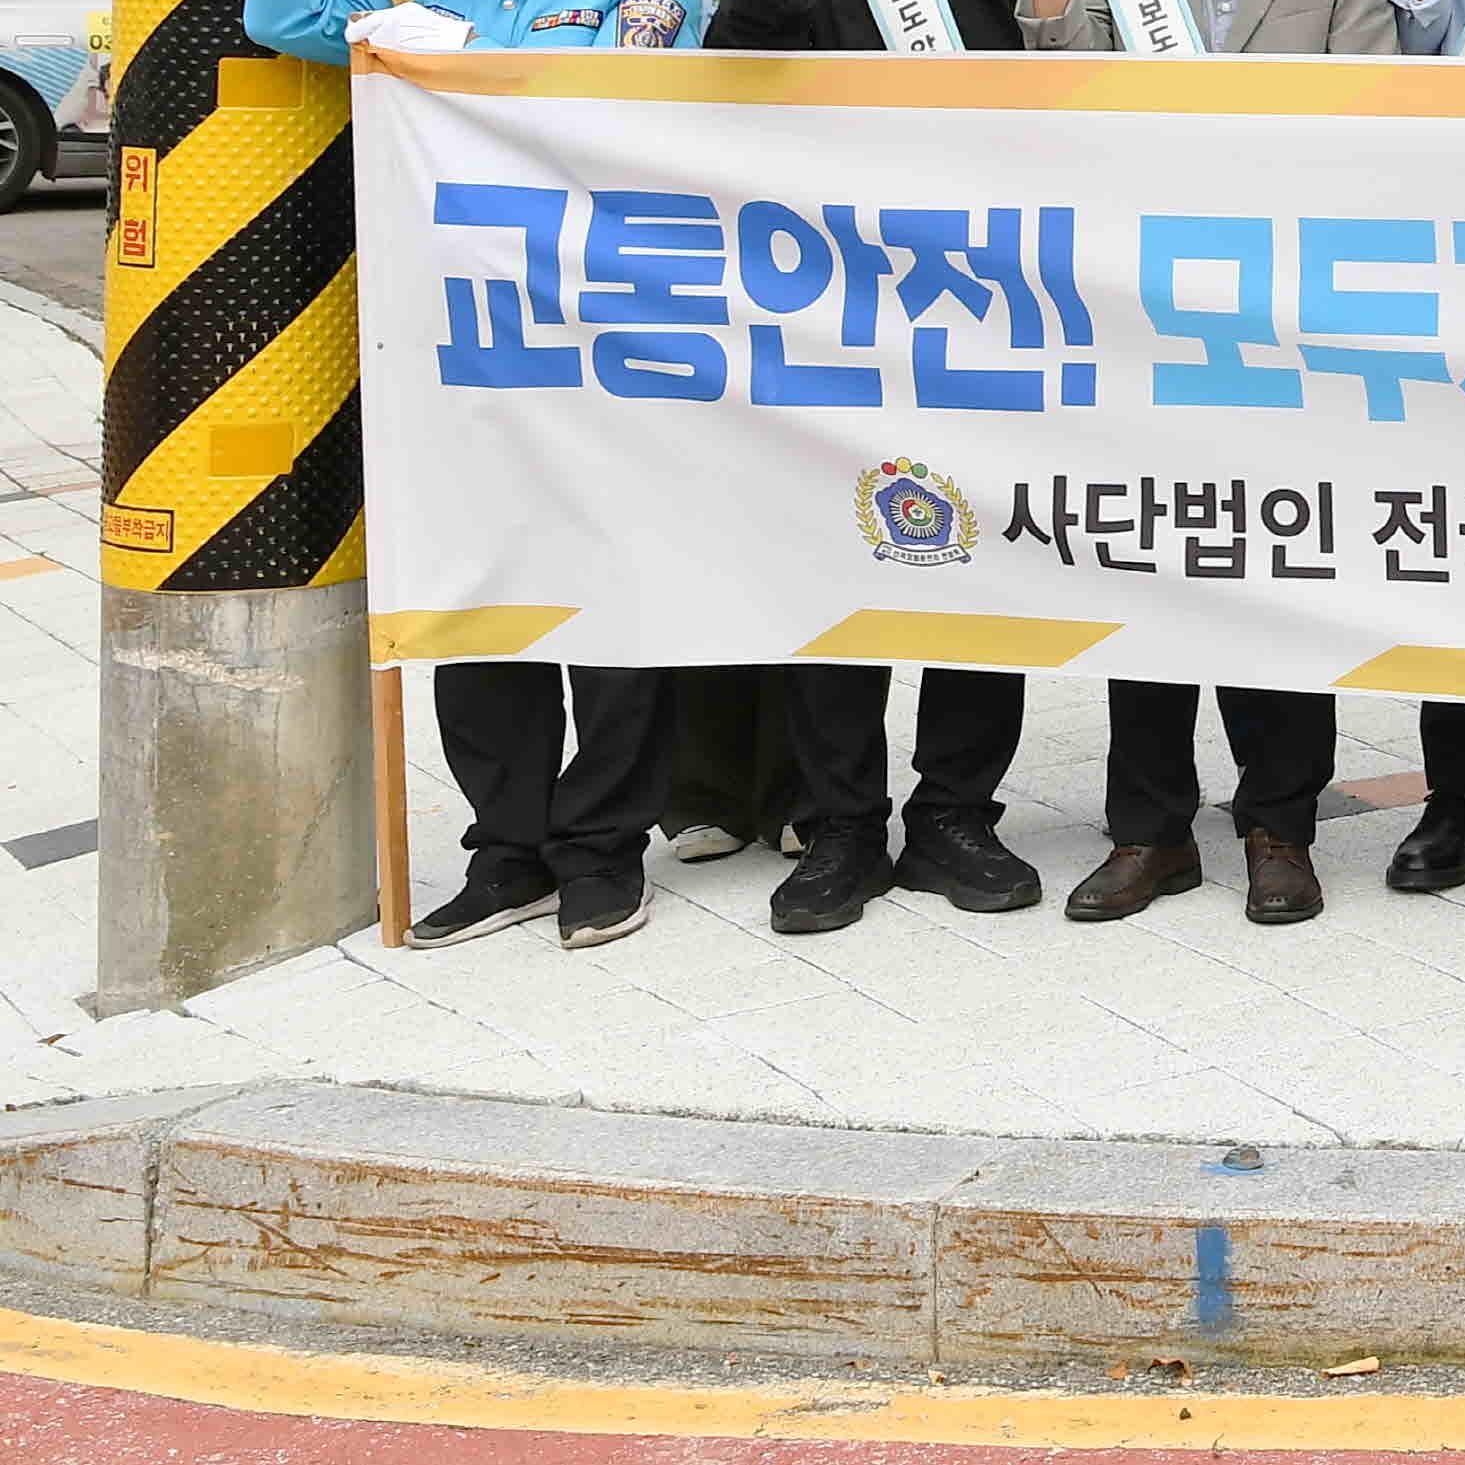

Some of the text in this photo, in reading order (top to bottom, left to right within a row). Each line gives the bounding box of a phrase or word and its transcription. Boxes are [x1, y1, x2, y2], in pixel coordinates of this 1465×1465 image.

[123, 153, 149, 257] 위험
[434, 182, 1097, 412] 교통안전!
[1001, 475, 1335, 580] 사단법인
